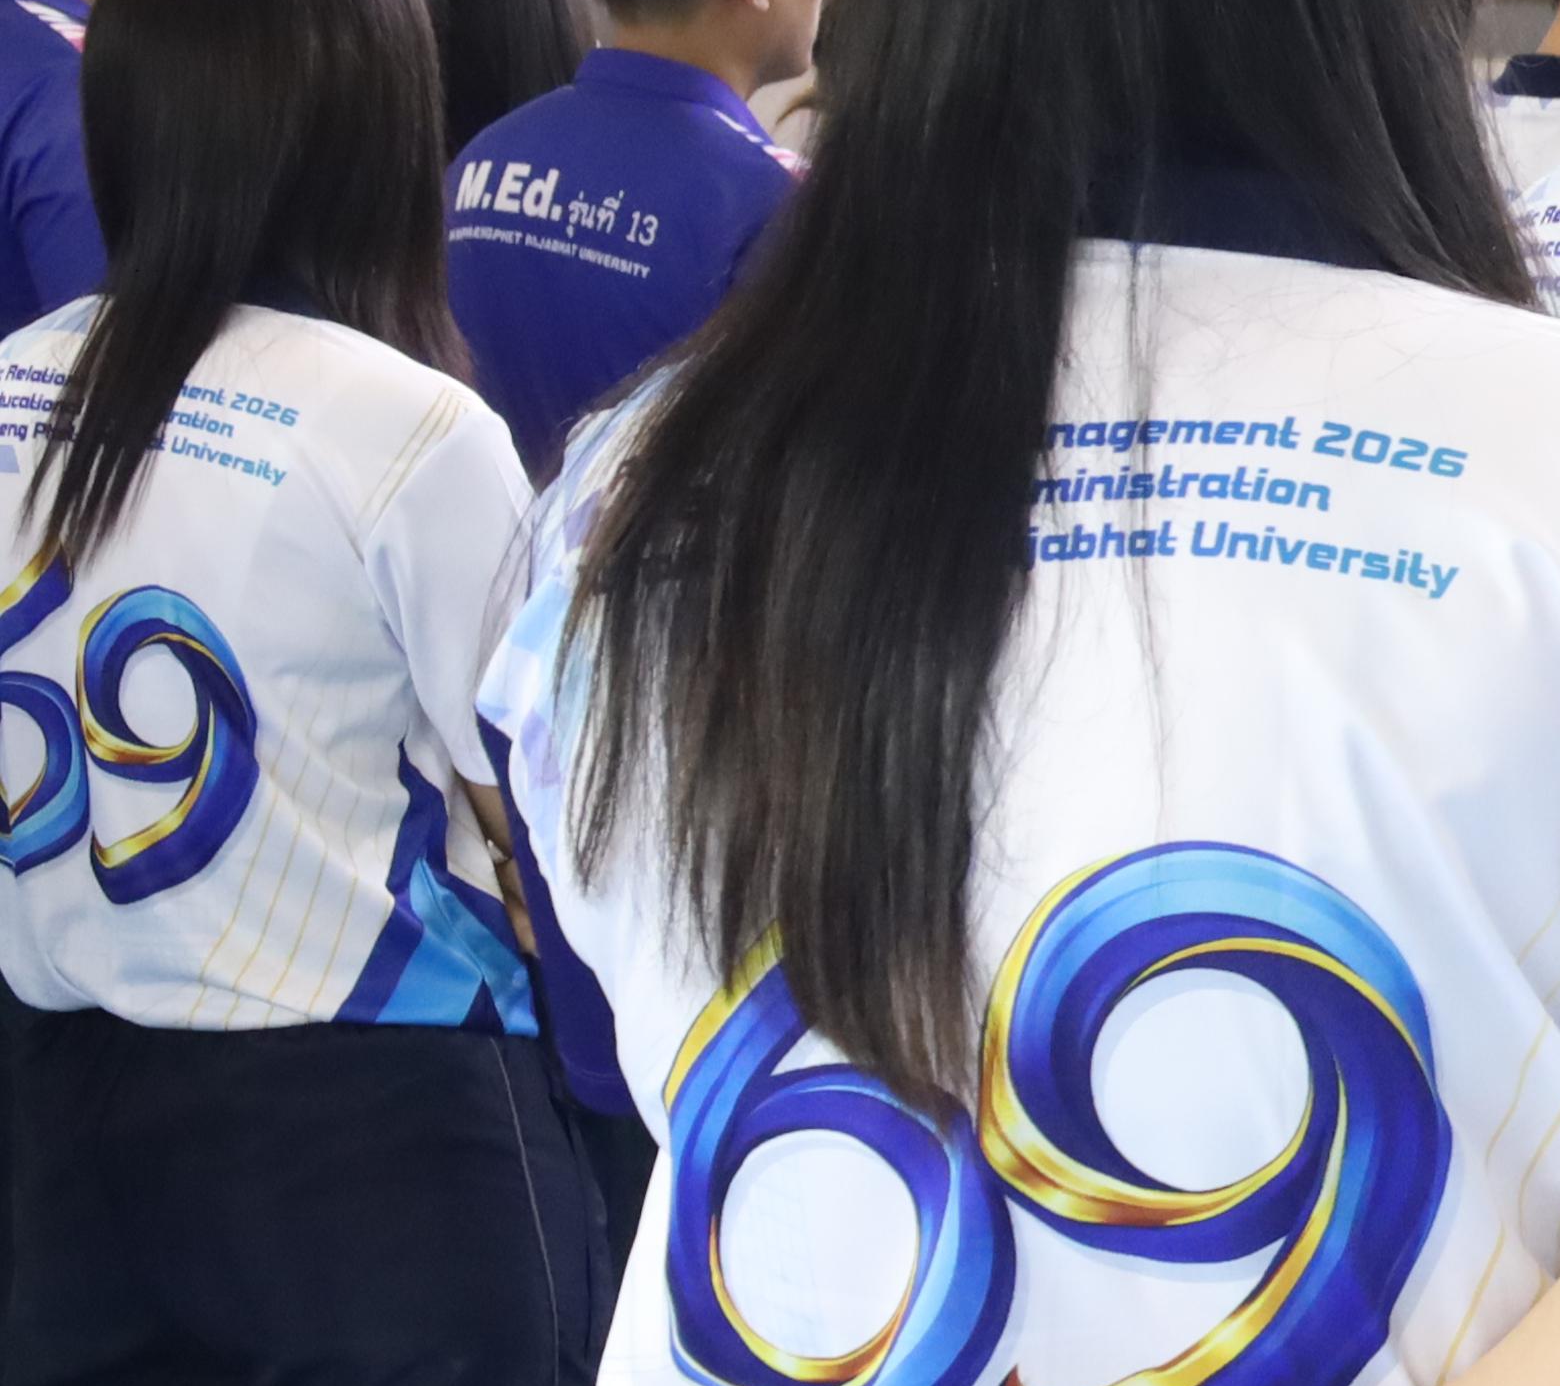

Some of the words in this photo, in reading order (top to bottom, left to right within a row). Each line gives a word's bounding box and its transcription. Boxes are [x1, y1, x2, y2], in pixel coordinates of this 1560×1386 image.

[455, 160, 563, 222] M.Ed.
[567, 189, 625, 239] รุ่นที่
[626, 211, 659, 246] 13
[578, 246, 650, 279] UNIVERSITY
[229, 392, 300, 428] 2026
[171, 434, 287, 487] University
[1046, 415, 1301, 454] nagement
[1312, 420, 1470, 480] 2026
[1031, 465, 1332, 513] ministration
[1025, 521, 1178, 571] jabhat
[1189, 520, 1461, 601] University
